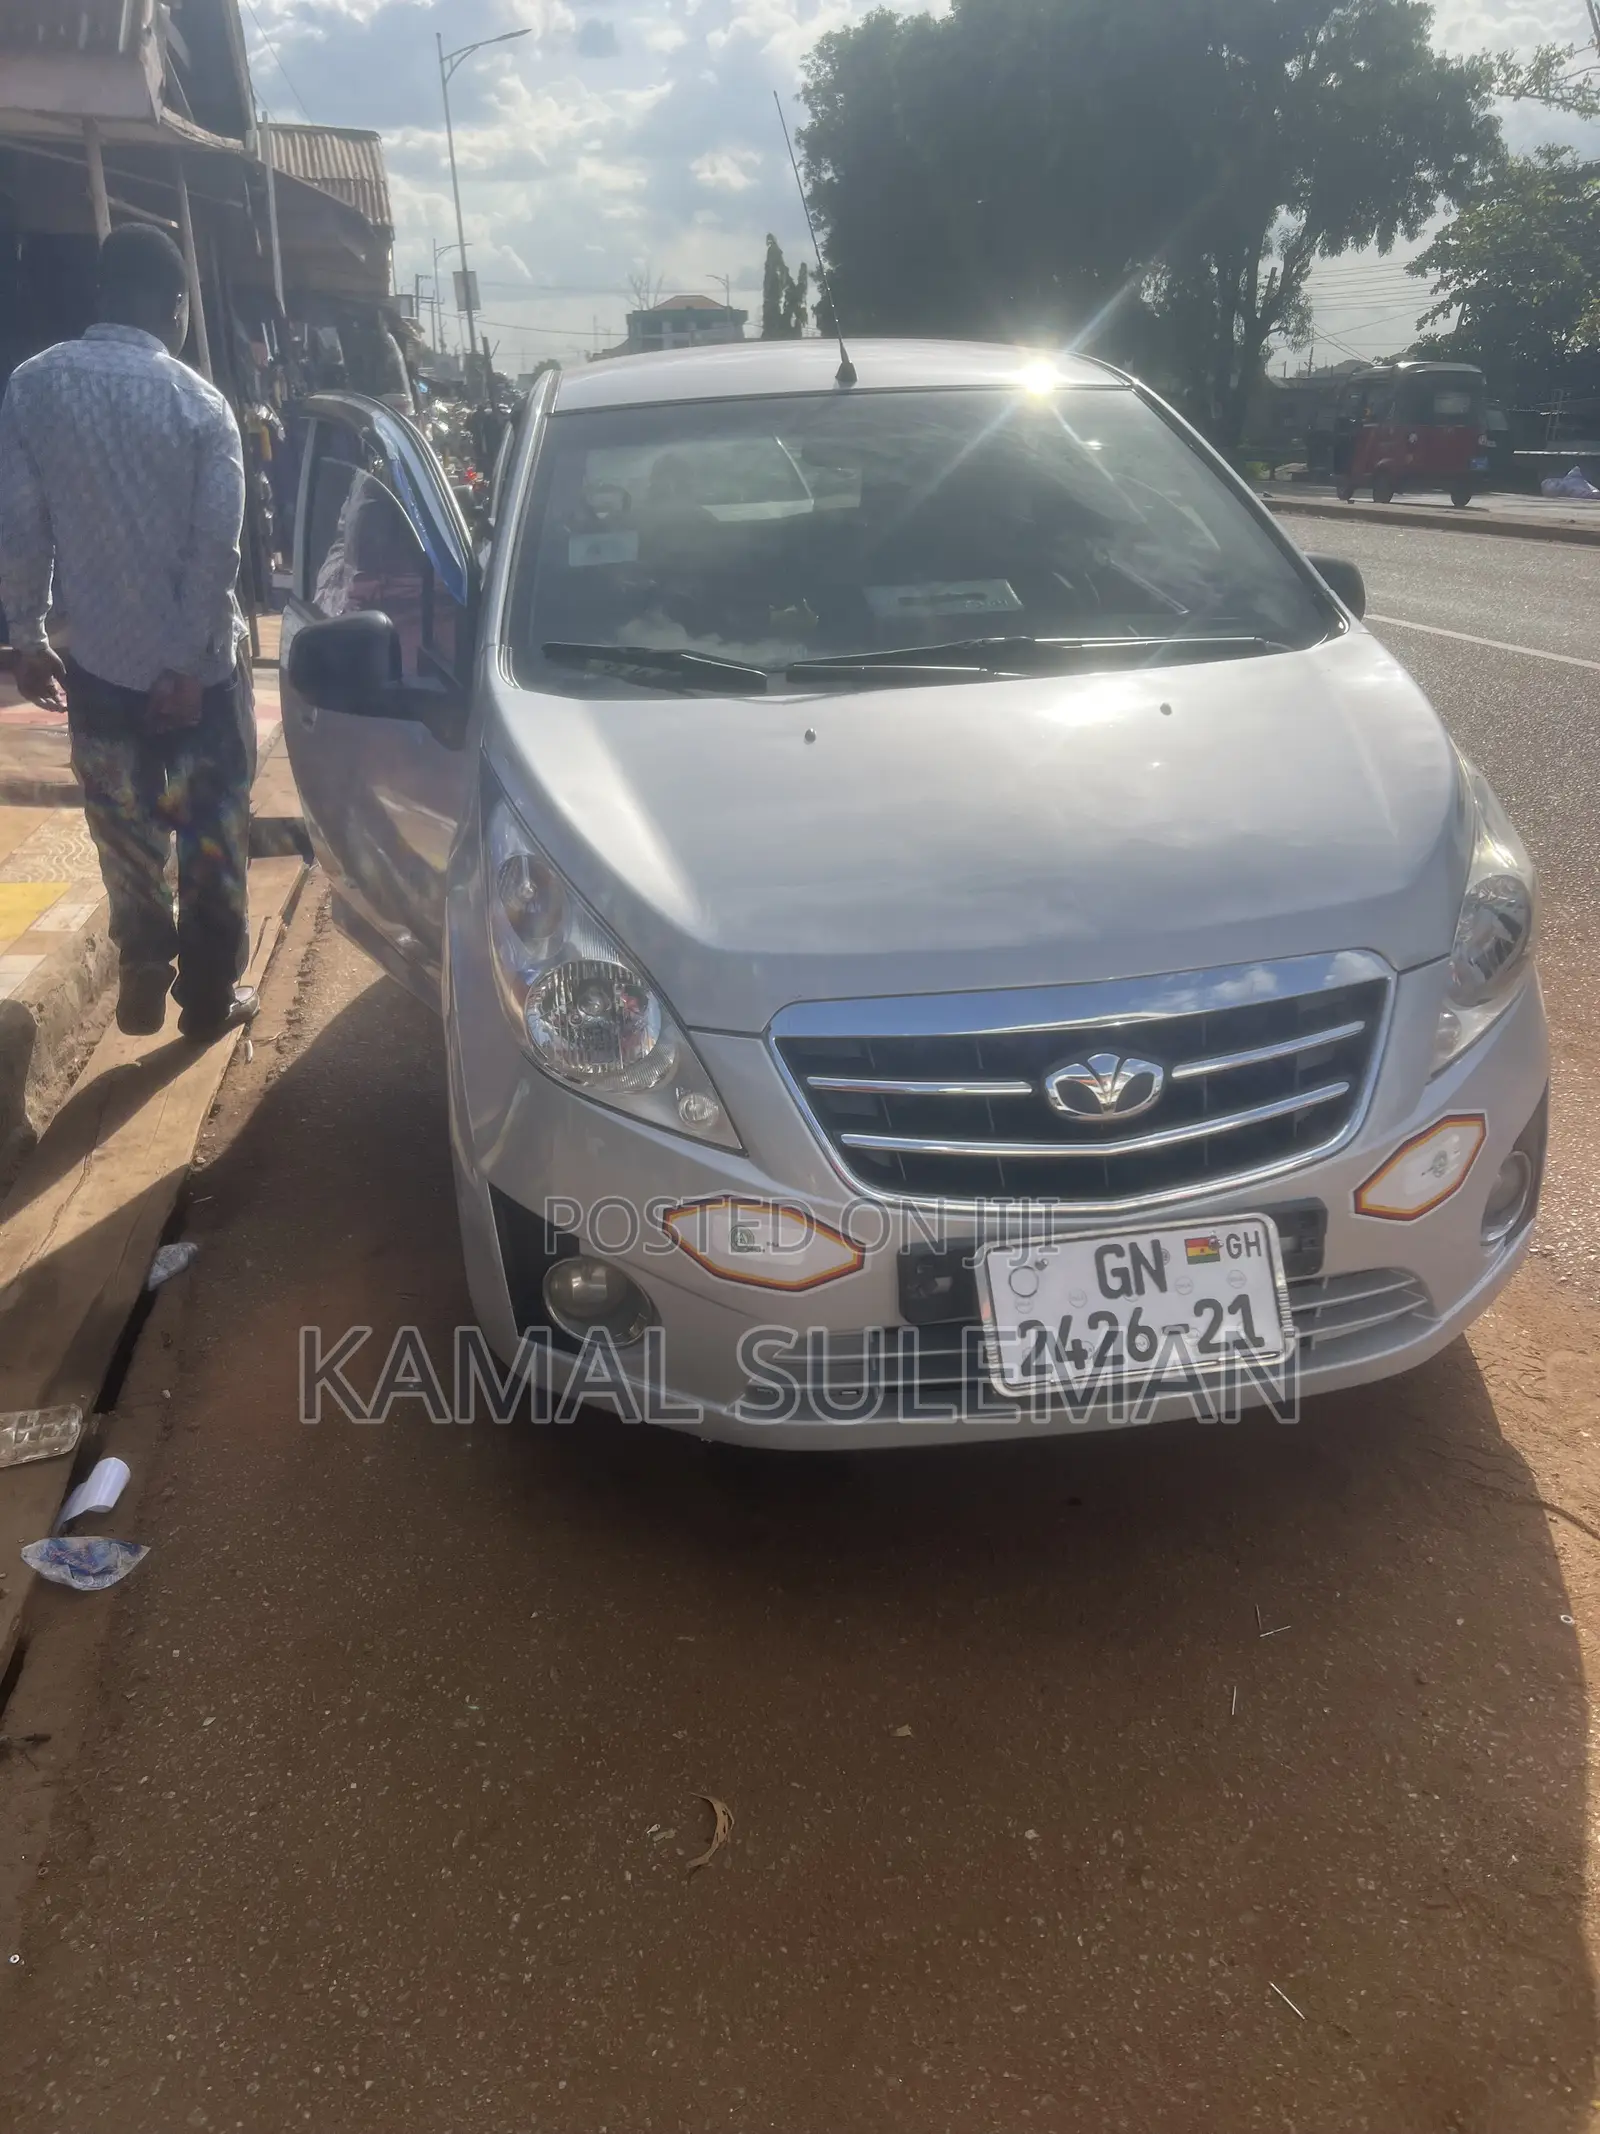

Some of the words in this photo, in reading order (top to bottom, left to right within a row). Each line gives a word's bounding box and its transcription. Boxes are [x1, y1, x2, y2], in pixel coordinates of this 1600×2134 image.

[1095, 1239, 1168, 1299] GN
[1226, 1231, 1262, 1260] GH
[1017, 1294, 1265, 1378] 2426-21
